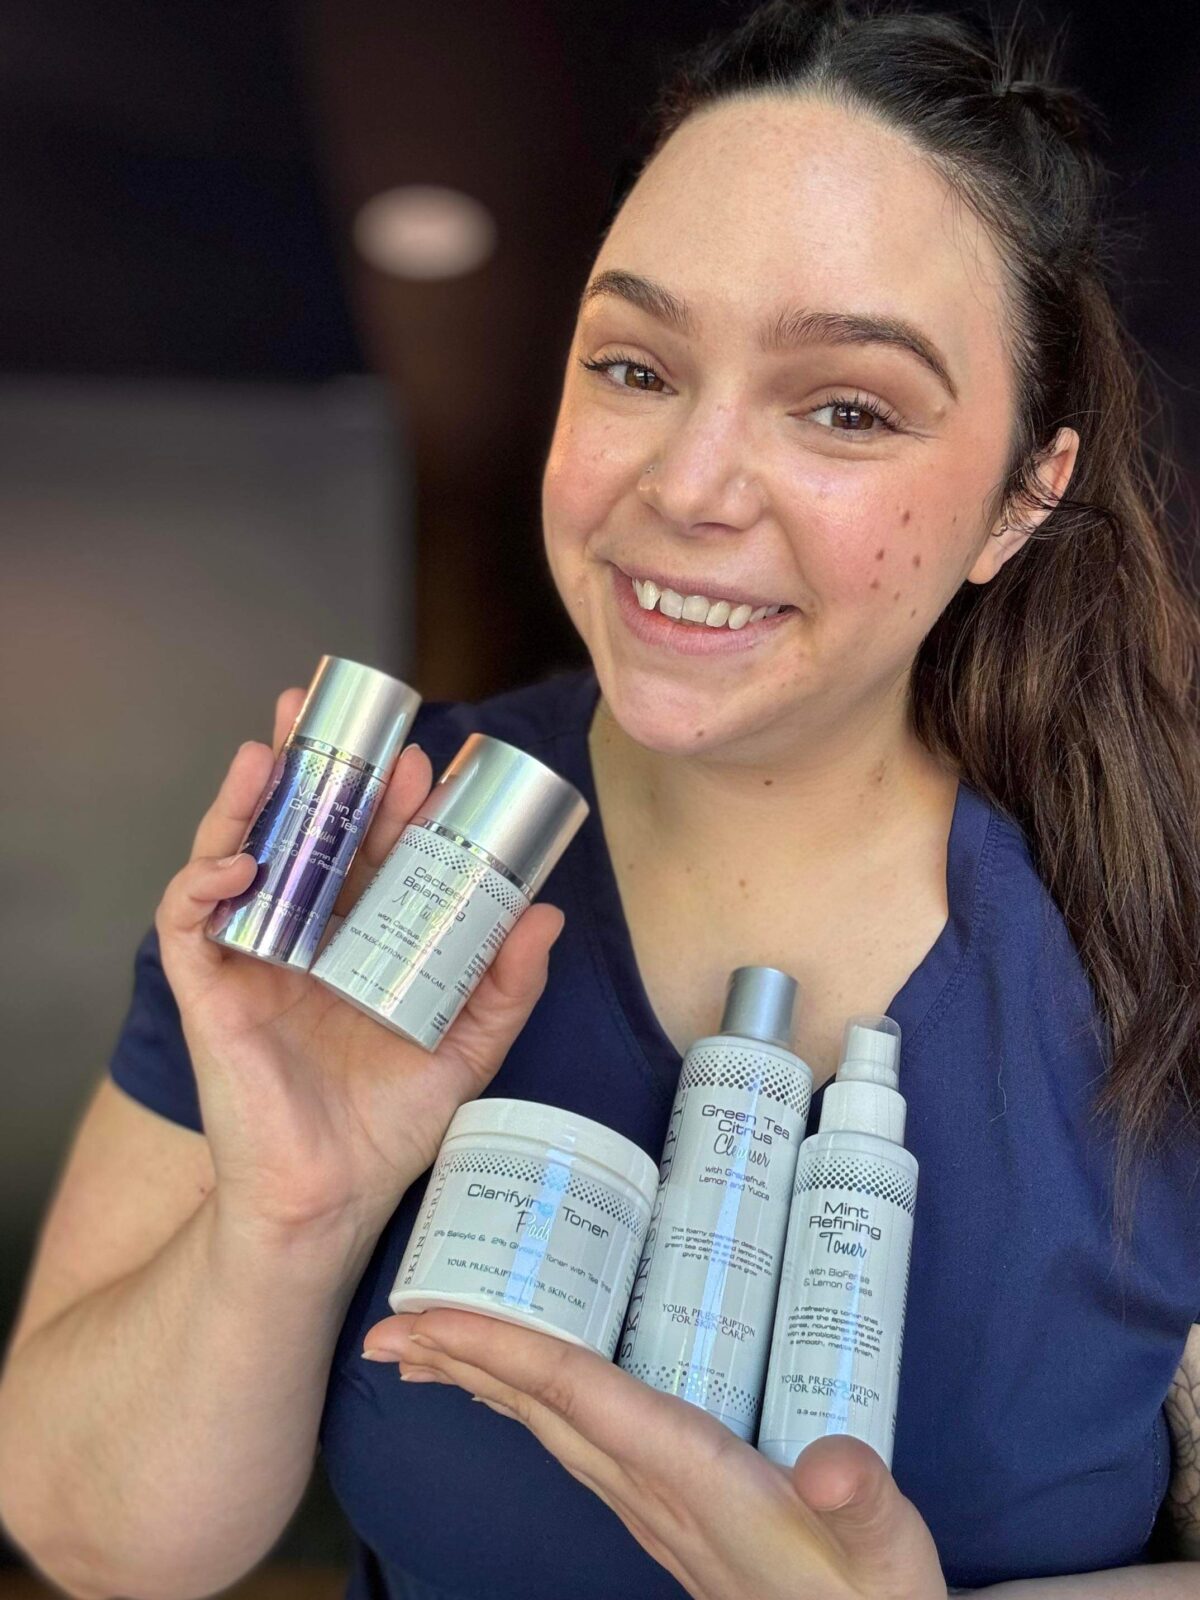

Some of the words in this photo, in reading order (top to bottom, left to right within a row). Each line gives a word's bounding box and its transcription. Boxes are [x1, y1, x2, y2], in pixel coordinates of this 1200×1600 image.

[288, 797, 335, 824] Gren
[340, 816, 359, 834] Tea
[352, 808, 363, 821] C
[701, 1104, 757, 1126] Green
[763, 1116, 790, 1141] Tea
[717, 1119, 773, 1145] Citrus
[705, 1166, 723, 1175] with
[698, 1175, 728, 1187] Lemon
[729, 1181, 746, 1192] and
[747, 1184, 770, 1201] Yucca
[467, 1183, 554, 1217] Clarifying
[562, 1205, 610, 1240] Toner
[823, 1201, 870, 1220] Mint
[515, 1209, 552, 1242] Pads
[808, 1214, 882, 1241] Refining
[681, 1251, 703, 1261] giving
[818, 1231, 868, 1259] Toner
[545, 1253, 569, 1268] Toner
[570, 1265, 587, 1279] with
[587, 1272, 600, 1286] Tea
[808, 1268, 826, 1276] with
[446, 1258, 468, 1269] YOUR
[547, 1285, 568, 1300] SKIN
[567, 1294, 586, 1310] CARE
[803, 1278, 811, 1287] &
[812, 1278, 843, 1289] Lemon
[662, 1303, 688, 1316] YOUR
[690, 1307, 756, 1338] PRESCRIPTION
[800, 1305, 838, 1316] refreshing
[671, 1313, 692, 1325] FOR
[693, 1319, 719, 1331] SKIN
[720, 1326, 746, 1342] CARE
[816, 1314, 829, 1322] the
[876, 1328, 884, 1336] of
[781, 1374, 804, 1385] YOUR
[789, 1383, 809, 1394] FOR
[811, 1384, 838, 1398] SKIN
[840, 1390, 869, 1408] CARE
